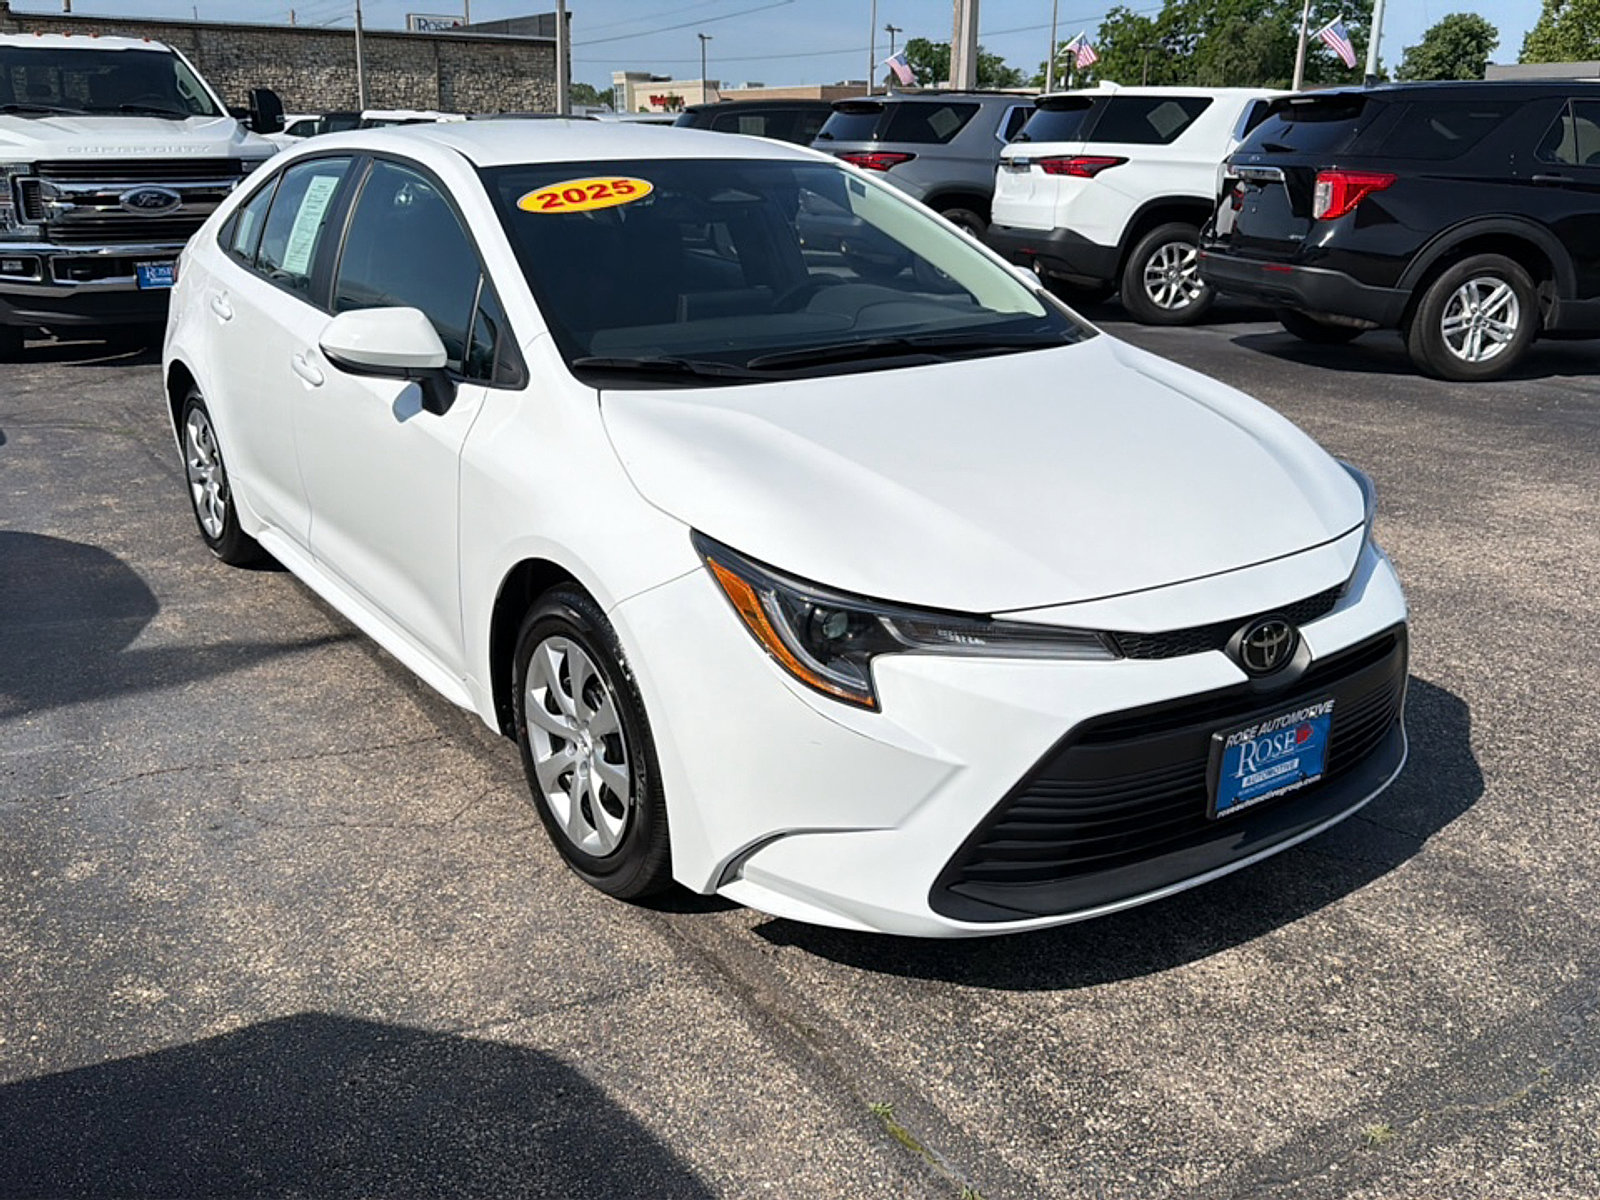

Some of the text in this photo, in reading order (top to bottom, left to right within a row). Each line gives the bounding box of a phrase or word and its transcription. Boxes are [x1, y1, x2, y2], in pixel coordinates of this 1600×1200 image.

[152, 144, 211, 154] DUTY
[536, 179, 637, 210] 2025
[1225, 724, 1260, 749] ROSE
[1233, 727, 1297, 779] ROSE
